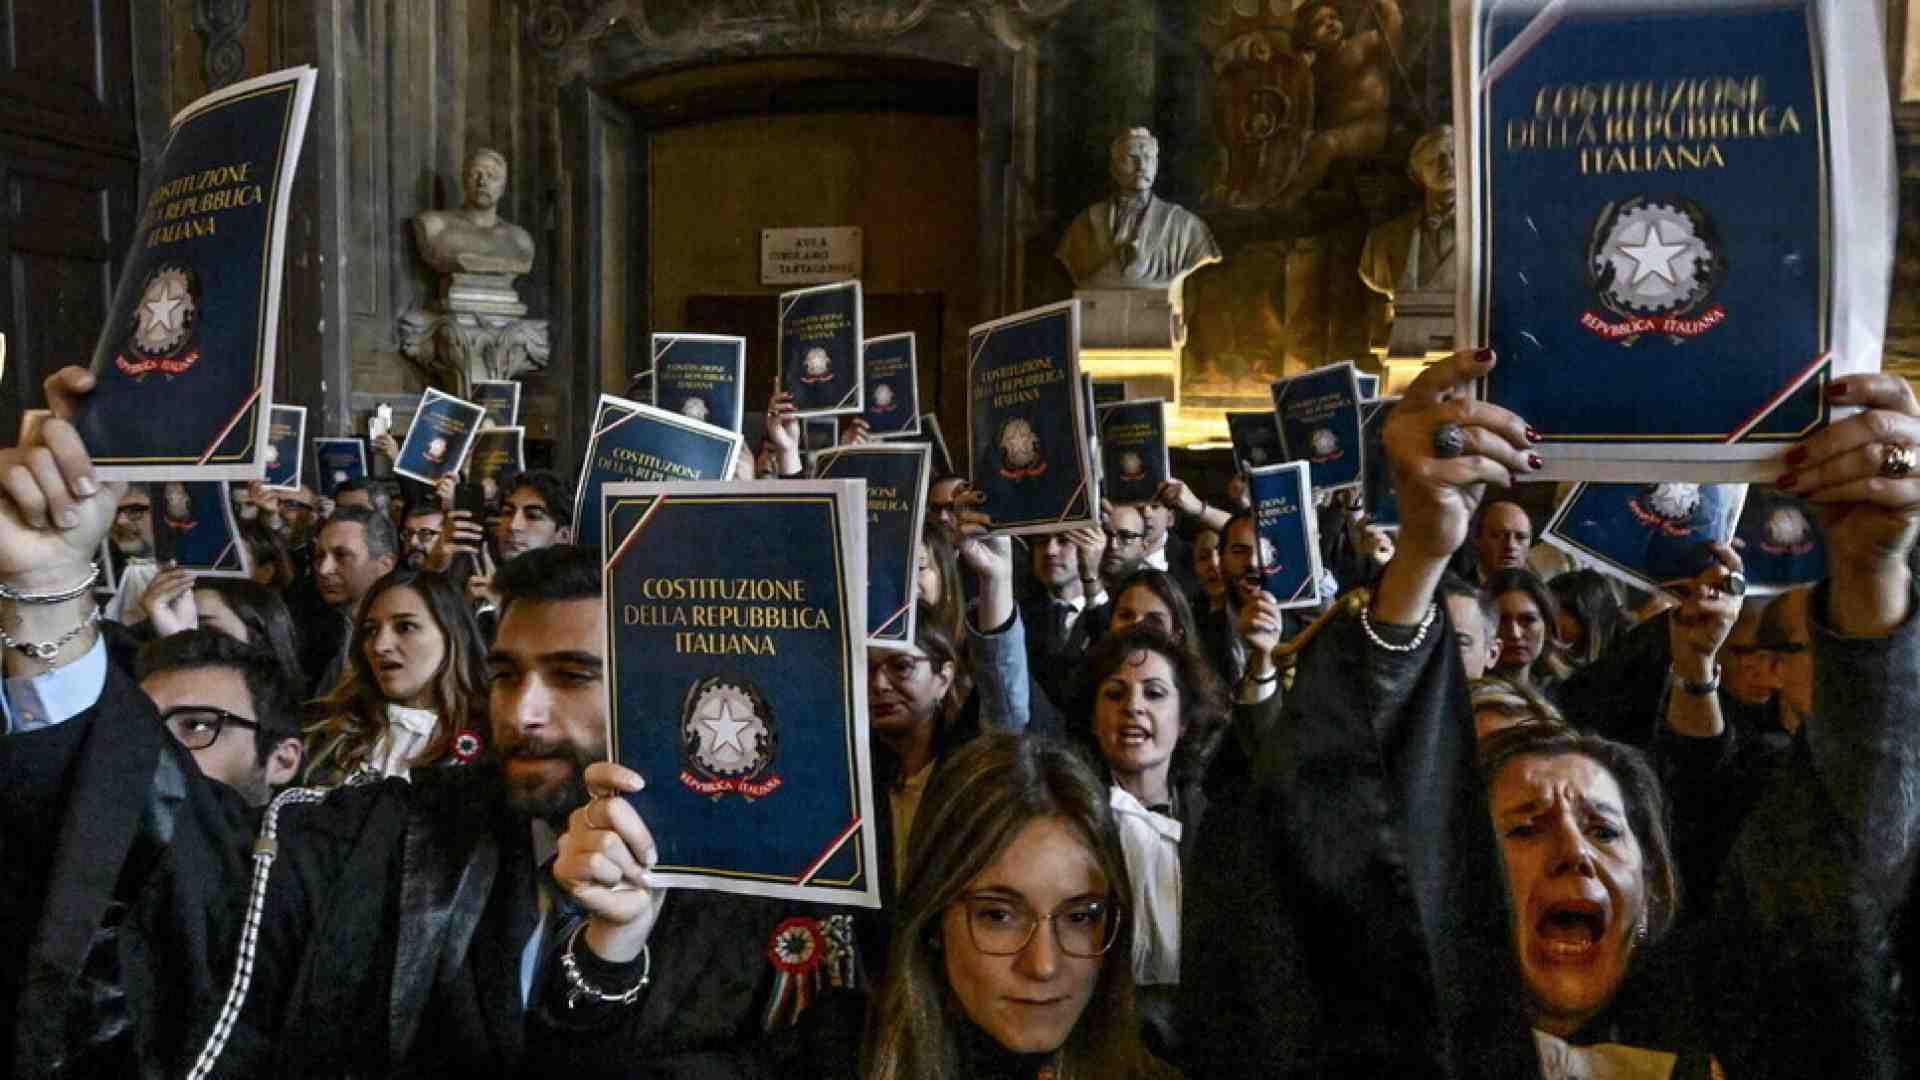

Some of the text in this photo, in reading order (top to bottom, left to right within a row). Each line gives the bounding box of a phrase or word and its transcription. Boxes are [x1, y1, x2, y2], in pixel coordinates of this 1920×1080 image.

[1535, 75, 1766, 117] COSTITUZIONE
[1507, 105, 1801, 149] DELLA REPUBBLICA
[1580, 143, 1726, 174] ITALIANA
[1663, 310, 1725, 335] ITALIANA
[612, 447, 702, 481] COSTITUZIONE
[643, 577, 806, 601] COSTITUZIONE
[624, 605, 831, 630] DELLA REPUBBLICA
[675, 632, 776, 656] ITALIANA
